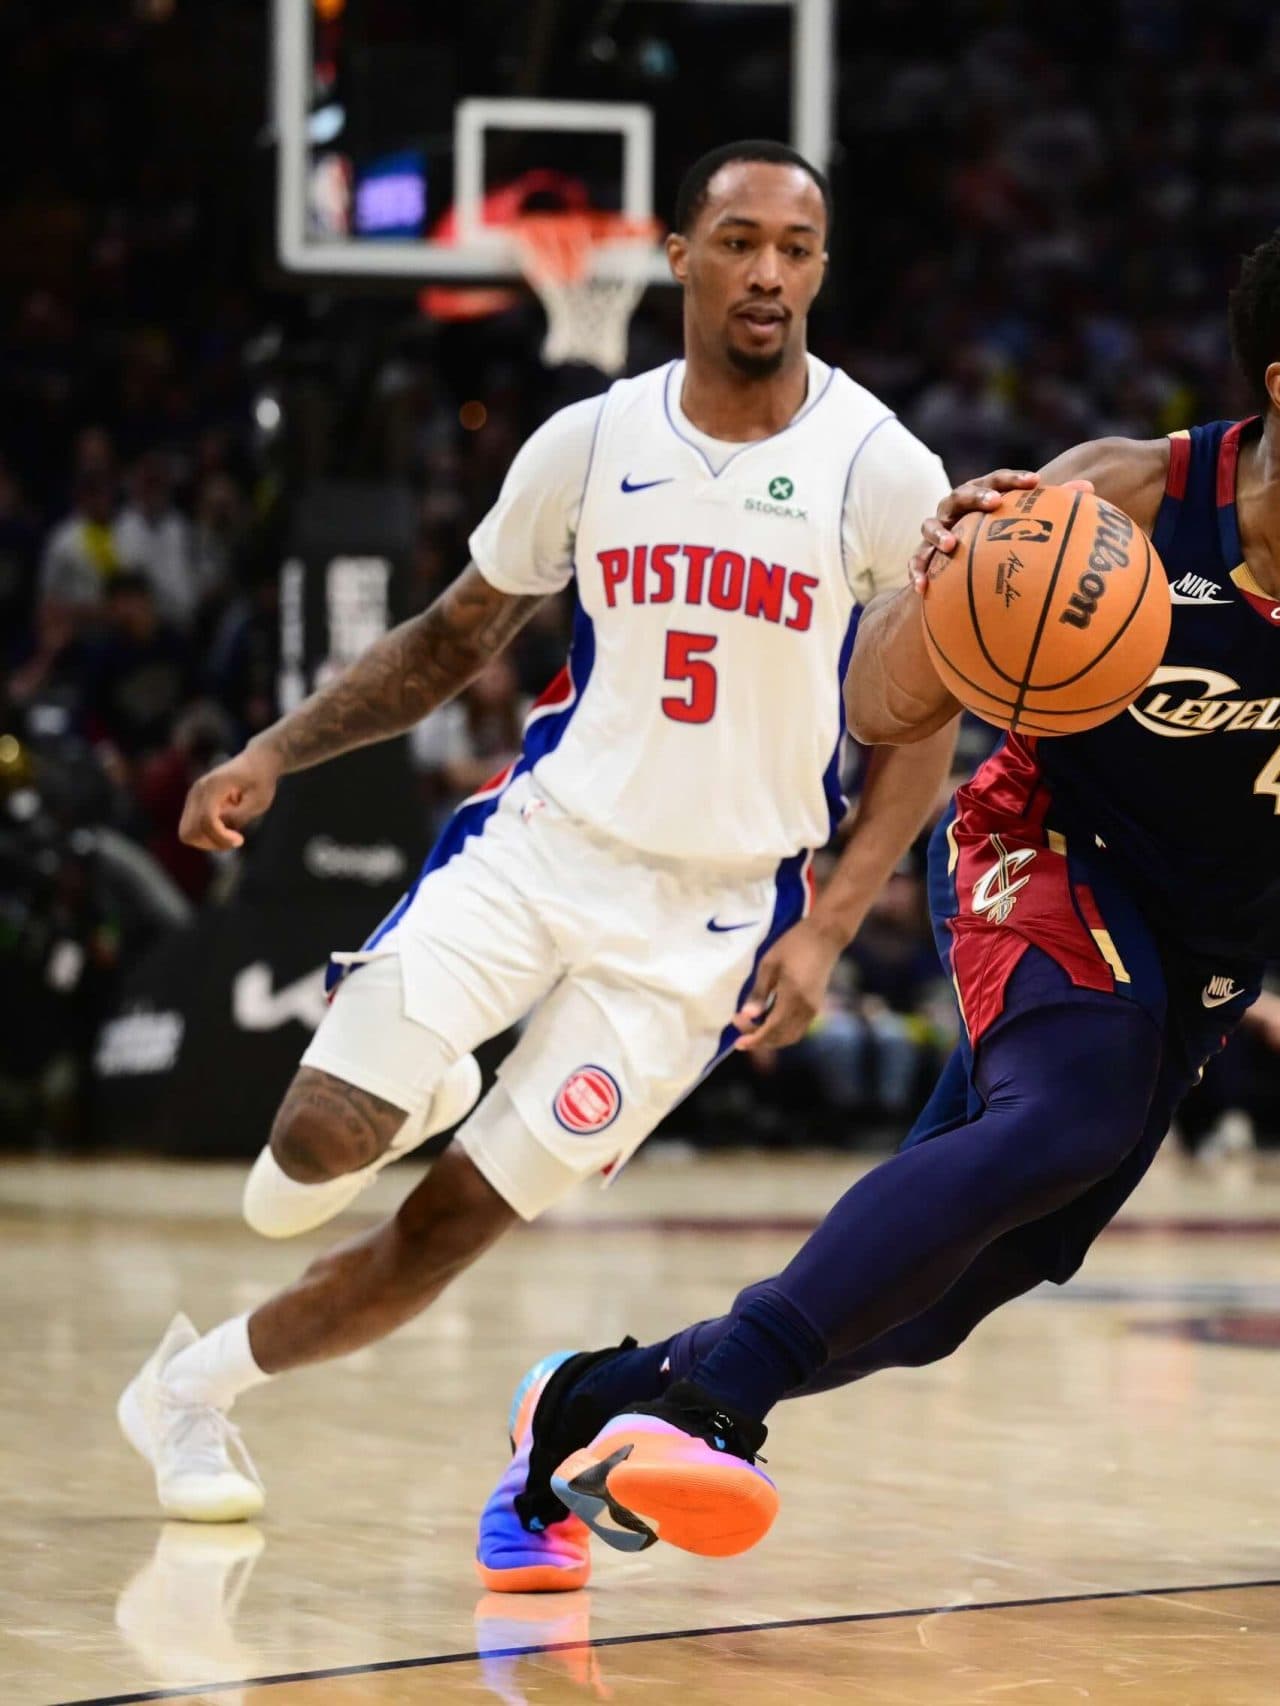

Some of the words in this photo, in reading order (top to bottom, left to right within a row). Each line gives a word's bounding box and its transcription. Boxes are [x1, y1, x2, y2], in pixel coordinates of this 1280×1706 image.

[597, 544, 820, 632] PISTONS
[1059, 501, 1134, 631] Wilson
[1176, 571, 1222, 600] NIKE
[661, 630, 718, 725] 5
[1208, 975, 1235, 997] NIKE
